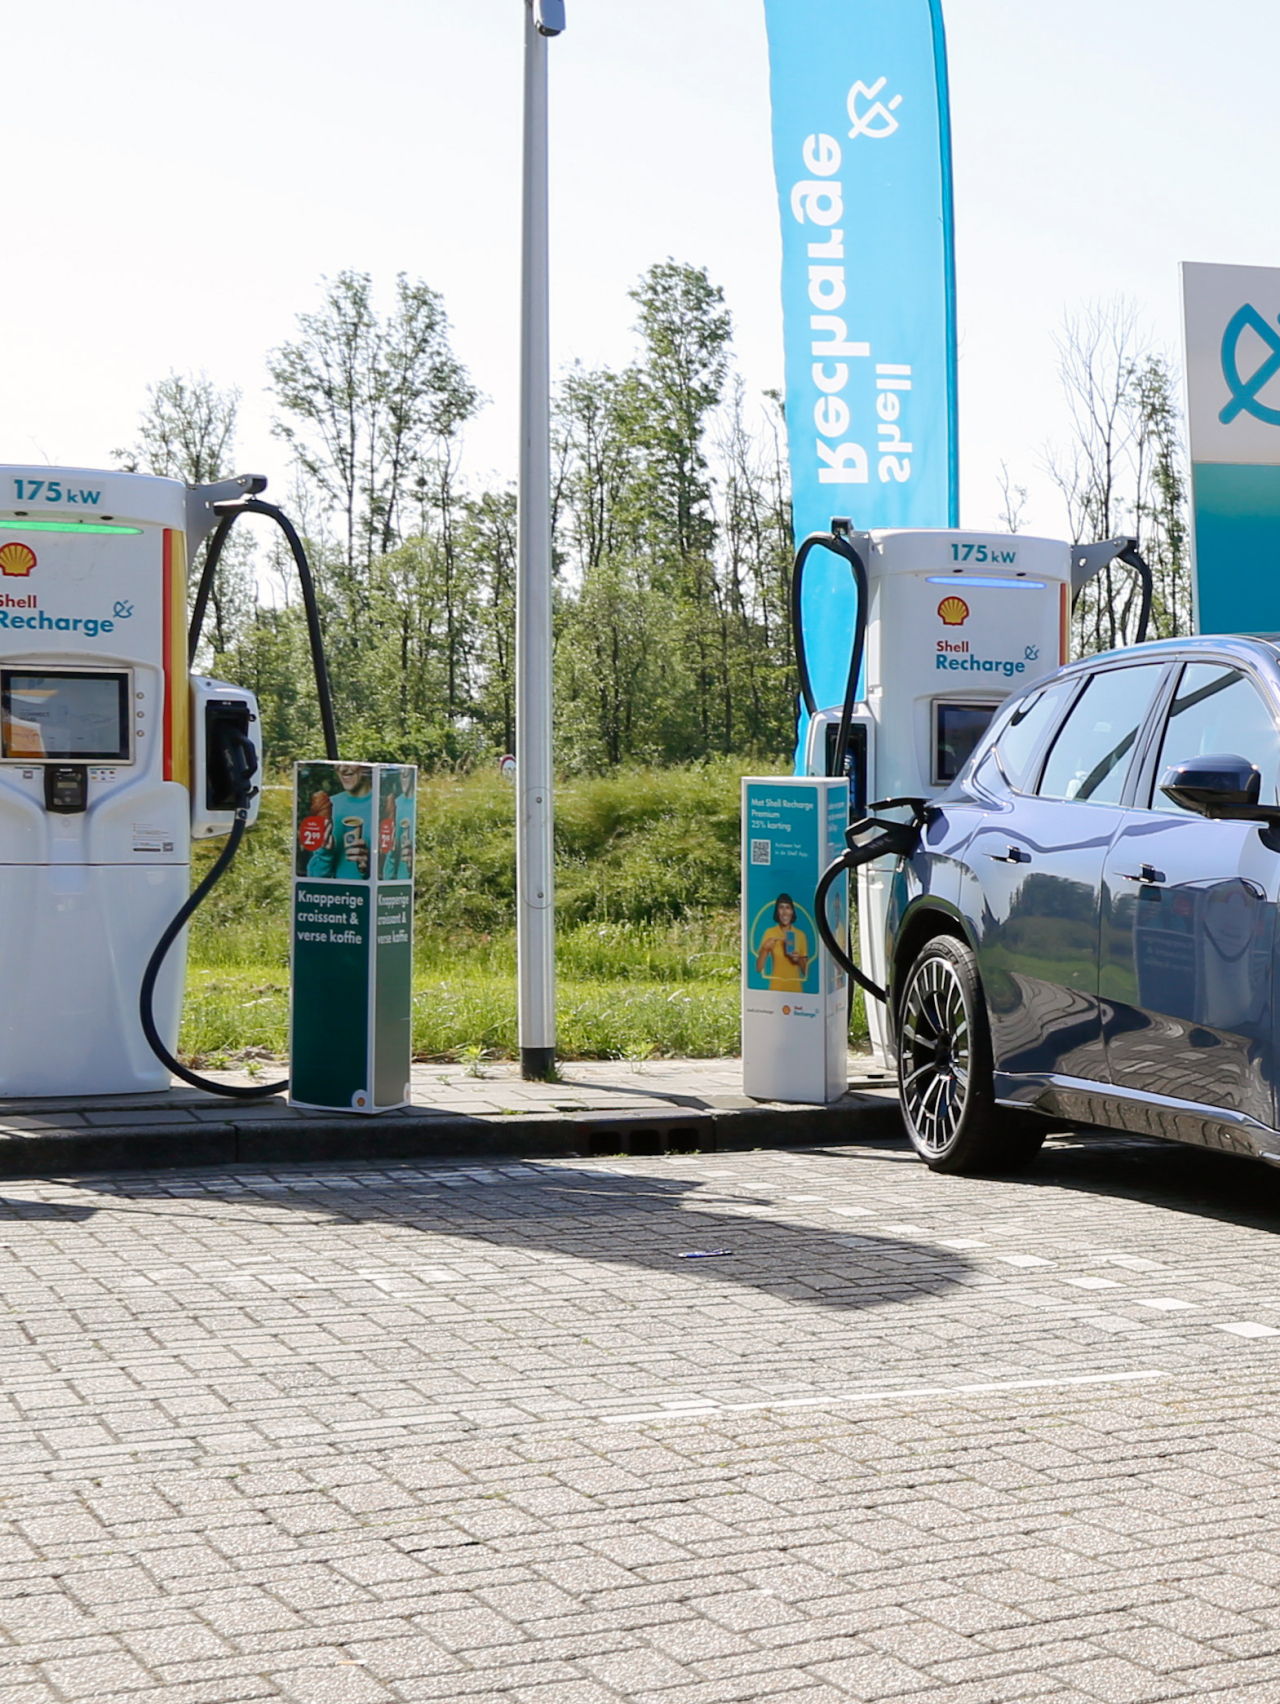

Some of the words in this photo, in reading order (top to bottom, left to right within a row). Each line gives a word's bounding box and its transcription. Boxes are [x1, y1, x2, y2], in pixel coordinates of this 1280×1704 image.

[14, 479, 62, 502] 175
[67, 489, 101, 505] kW
[951, 543, 988, 562] 175
[991, 550, 1016, 564] kW
[0, 610, 114, 637] Recharge
[936, 641, 969, 653] Shell
[936, 654, 1026, 677] Recharge
[751, 799, 765, 807] Met
[766, 799, 781, 807] Shell
[782, 800, 814, 811] Recharge
[751, 809, 780, 818] Premium
[751, 820, 766, 829] 25%
[767, 820, 791, 832] korting
[297, 890, 364, 909] Knapperige
[297, 909, 347, 925] croissant
[349, 911, 359, 925] &
[297, 930, 327, 942] verse
[329, 928, 363, 944] koffie
